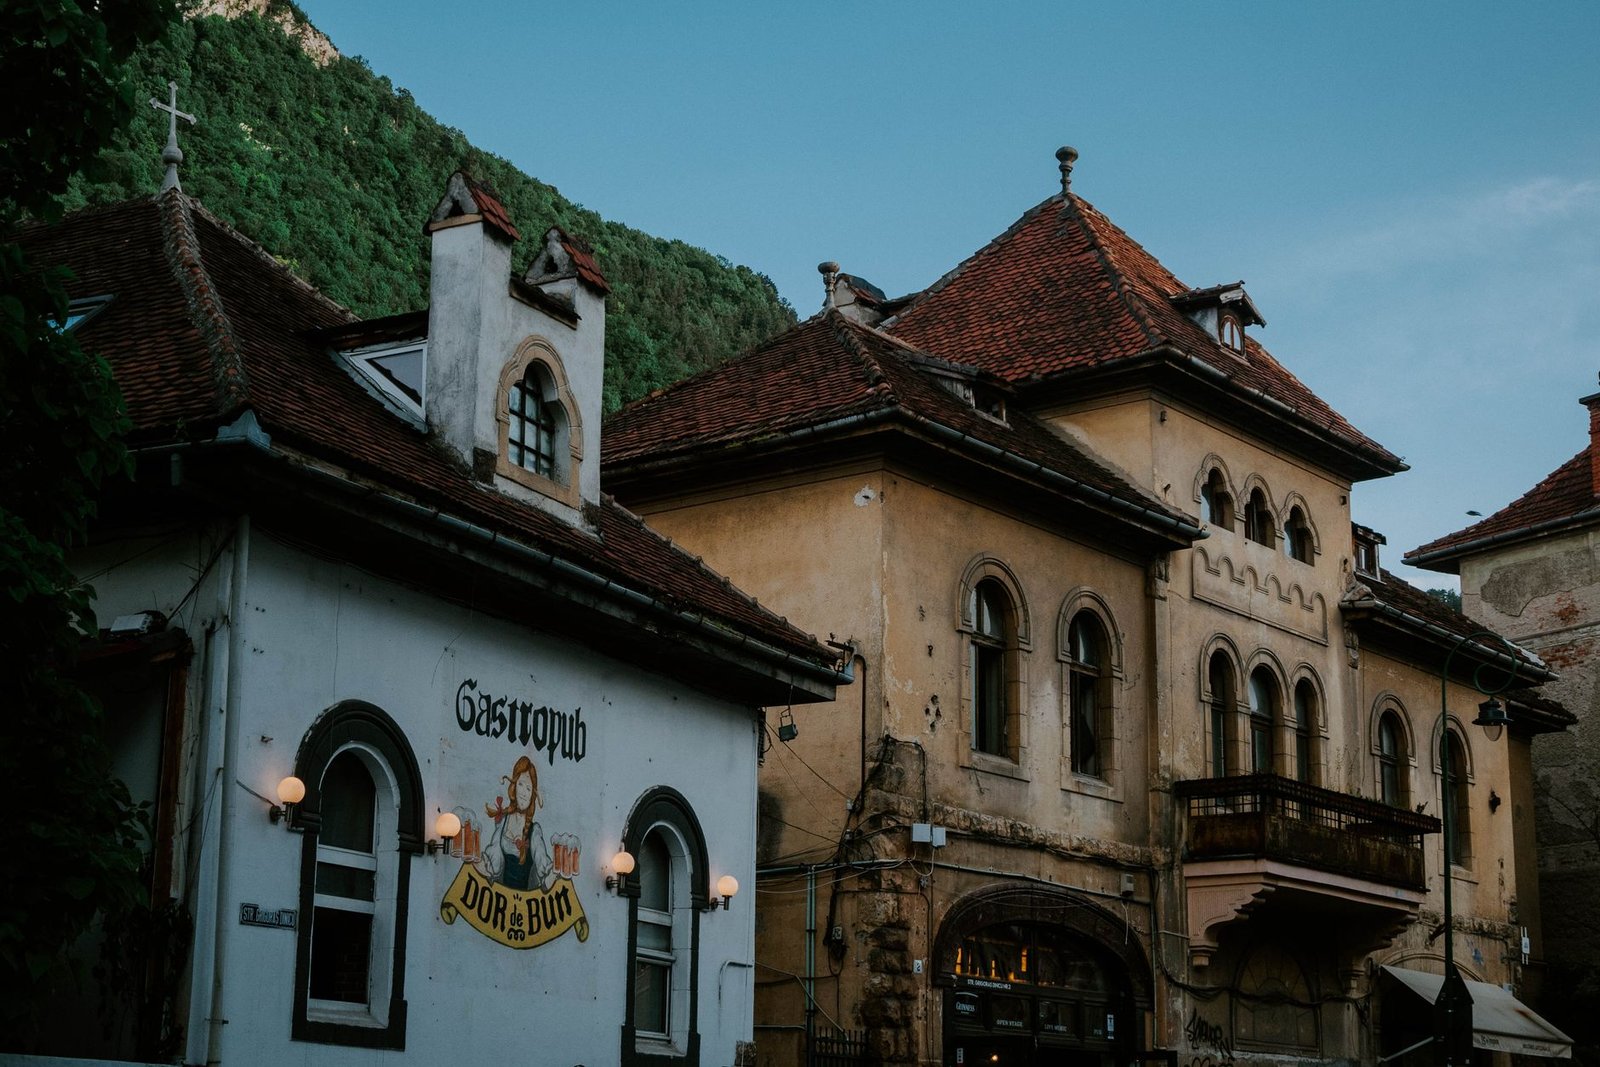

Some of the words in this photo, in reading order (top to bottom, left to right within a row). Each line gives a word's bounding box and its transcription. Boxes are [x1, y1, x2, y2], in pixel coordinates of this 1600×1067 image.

[456, 679, 586, 766] Gastropub
[460, 872, 508, 933] DOR
[511, 904, 524, 928] de
